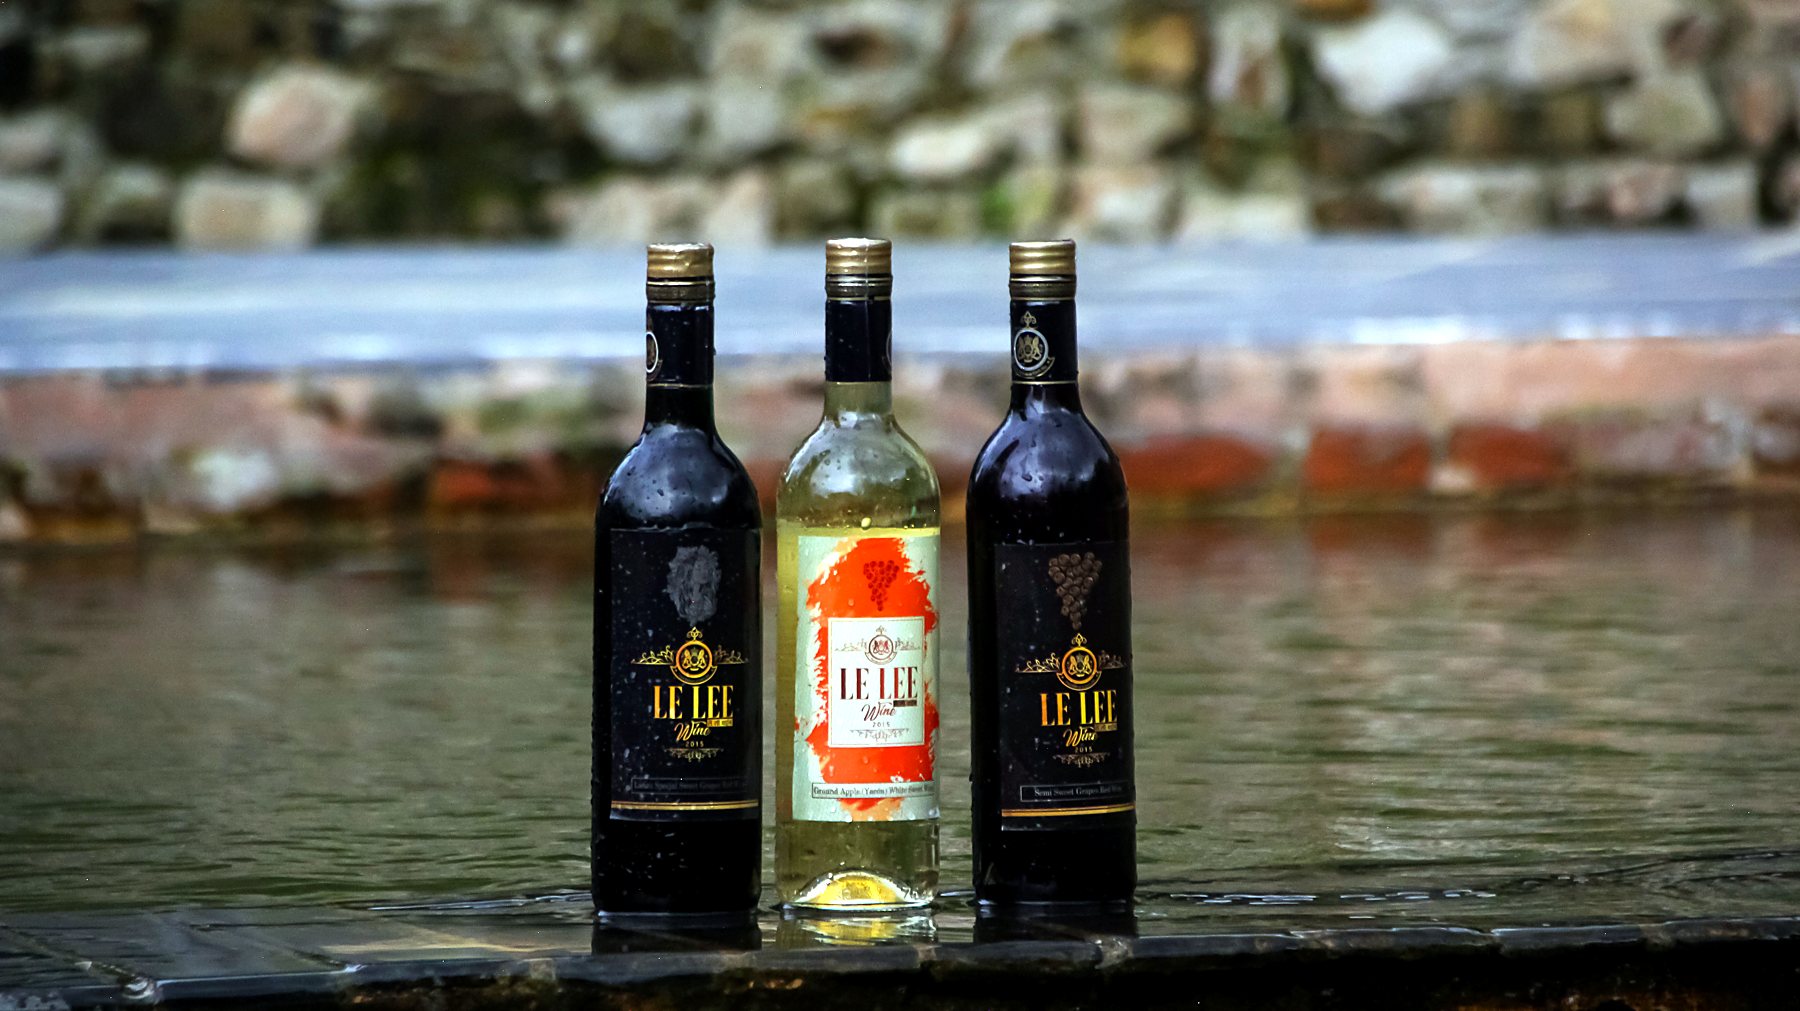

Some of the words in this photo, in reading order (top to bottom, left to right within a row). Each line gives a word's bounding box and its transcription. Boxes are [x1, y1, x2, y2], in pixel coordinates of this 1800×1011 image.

[840, 667, 870, 700] LE
[879, 666, 918, 700] LEE
[653, 685, 683, 719] LE
[691, 685, 734, 719] LEE
[861, 701, 896, 721] Wine
[1041, 692, 1071, 726] LE
[1079, 689, 1118, 725] LEE
[673, 720, 710, 741] Wine
[1062, 726, 1097, 747] Wine
[840, 786, 860, 797] Apple
